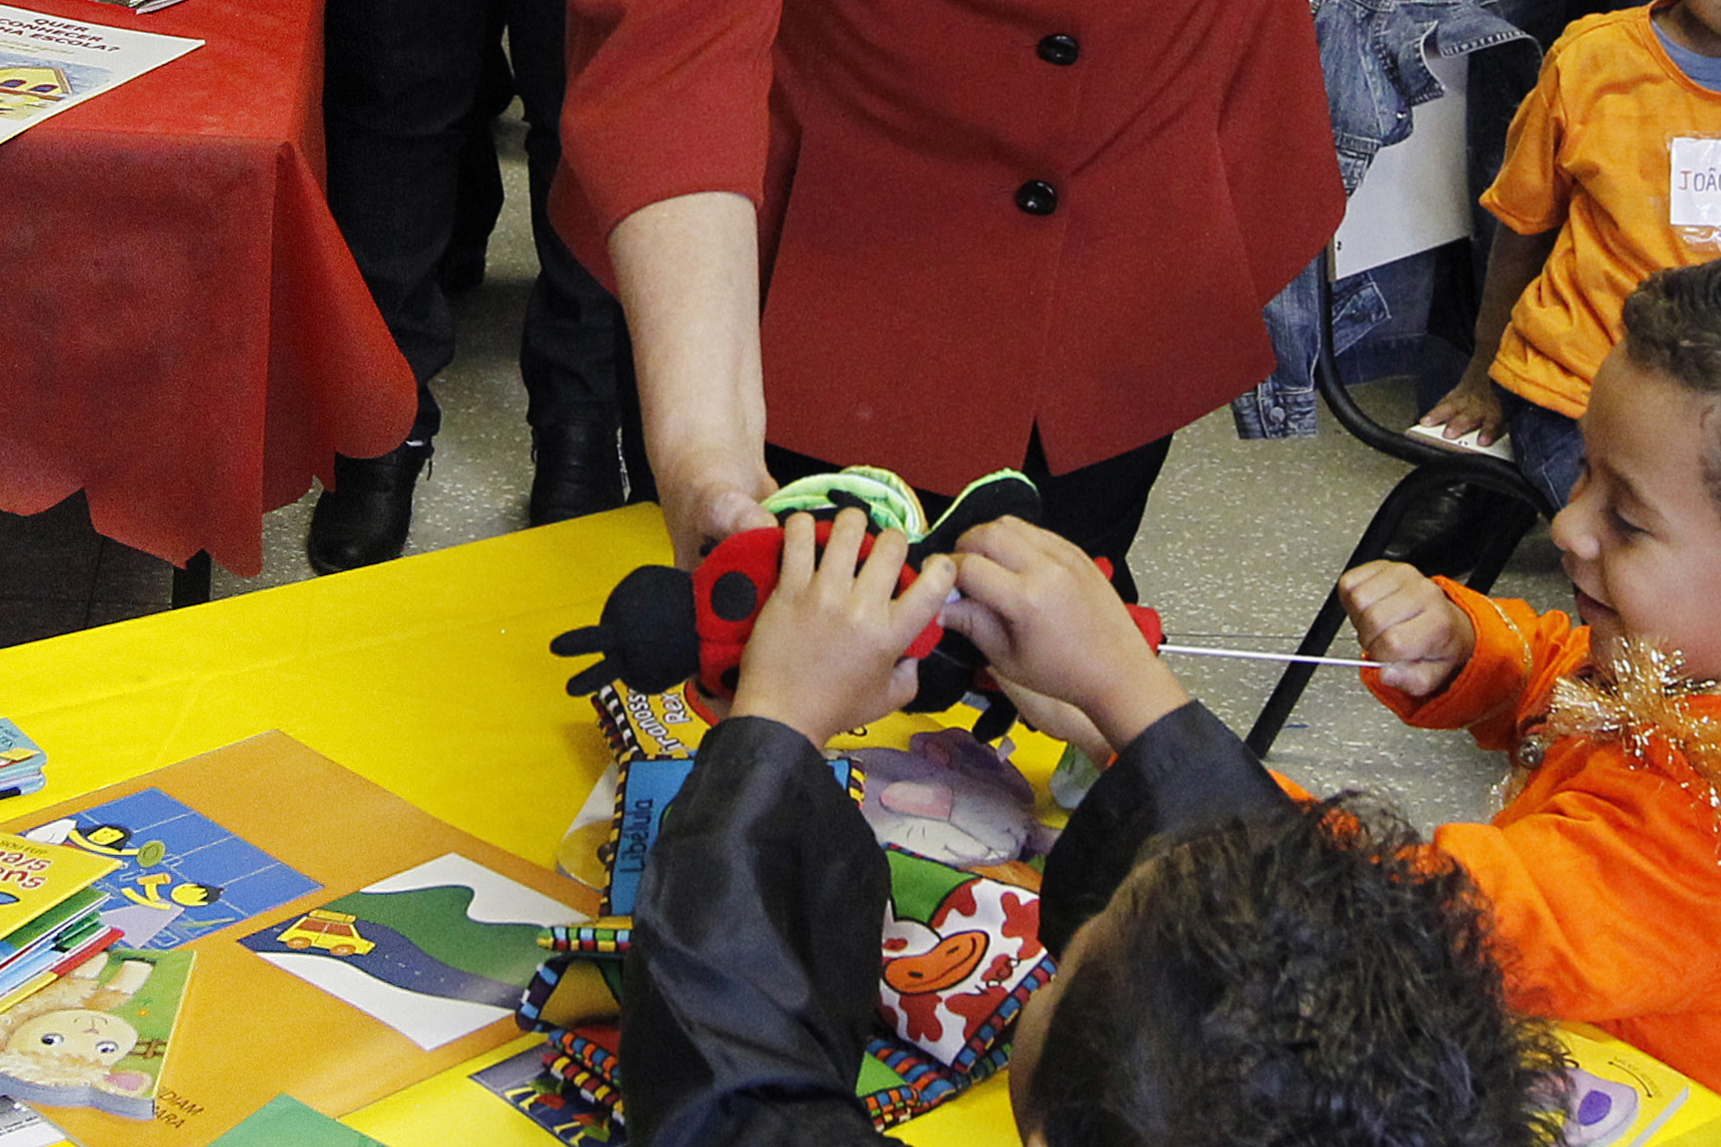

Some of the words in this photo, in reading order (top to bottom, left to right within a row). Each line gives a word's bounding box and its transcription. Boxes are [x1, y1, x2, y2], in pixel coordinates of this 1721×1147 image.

[34, 18, 89, 32] QUER
[31, 33, 120, 52] ESCOLA?
[662, 693, 692, 724] Rex
[619, 799, 654, 873] Libélula
